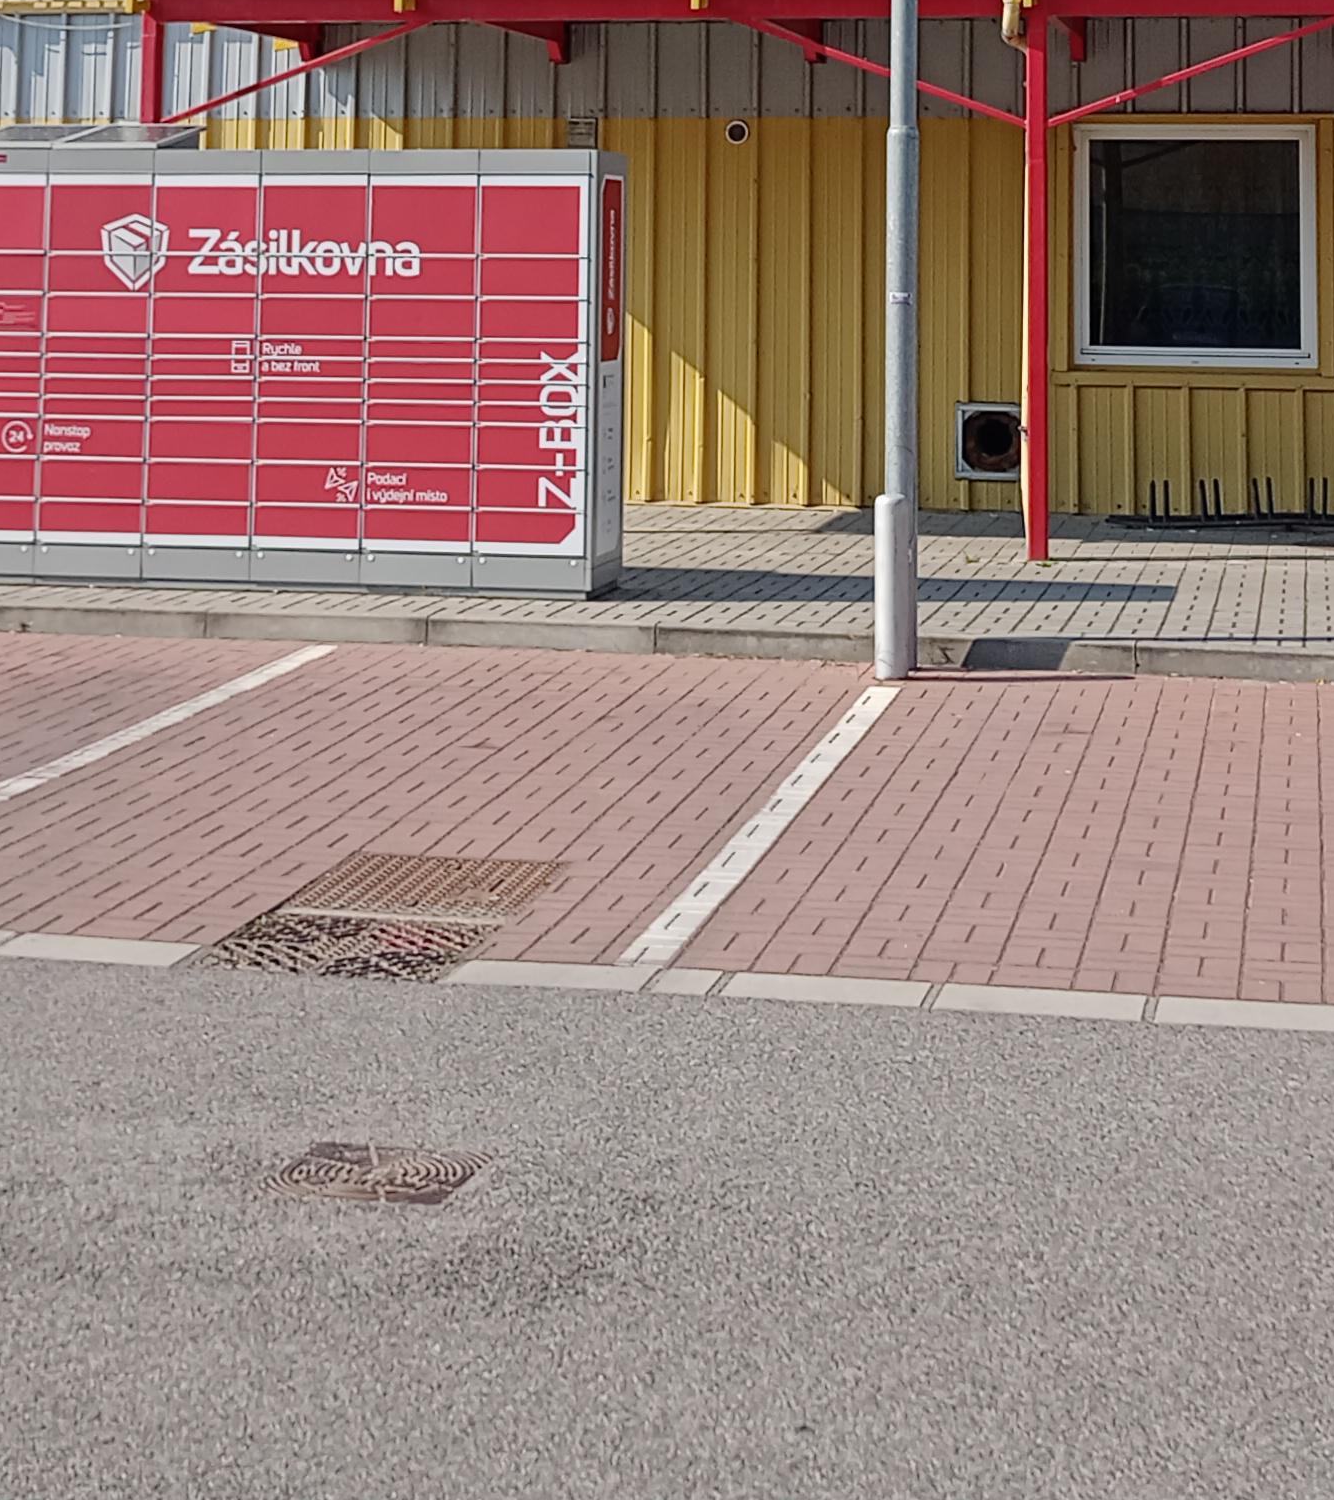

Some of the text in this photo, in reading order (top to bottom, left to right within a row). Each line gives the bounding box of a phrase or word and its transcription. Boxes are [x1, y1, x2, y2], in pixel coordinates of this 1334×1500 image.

[187, 228, 421, 277] Zásilkovna
[262, 342, 303, 356] Rychle
[261, 361, 320, 373] a bez front
[8, 429, 25, 443] 24
[44, 424, 91, 439] Nonstop
[538, 350, 578, 508] Z-BOX
[43, 441, 81, 453] provoz
